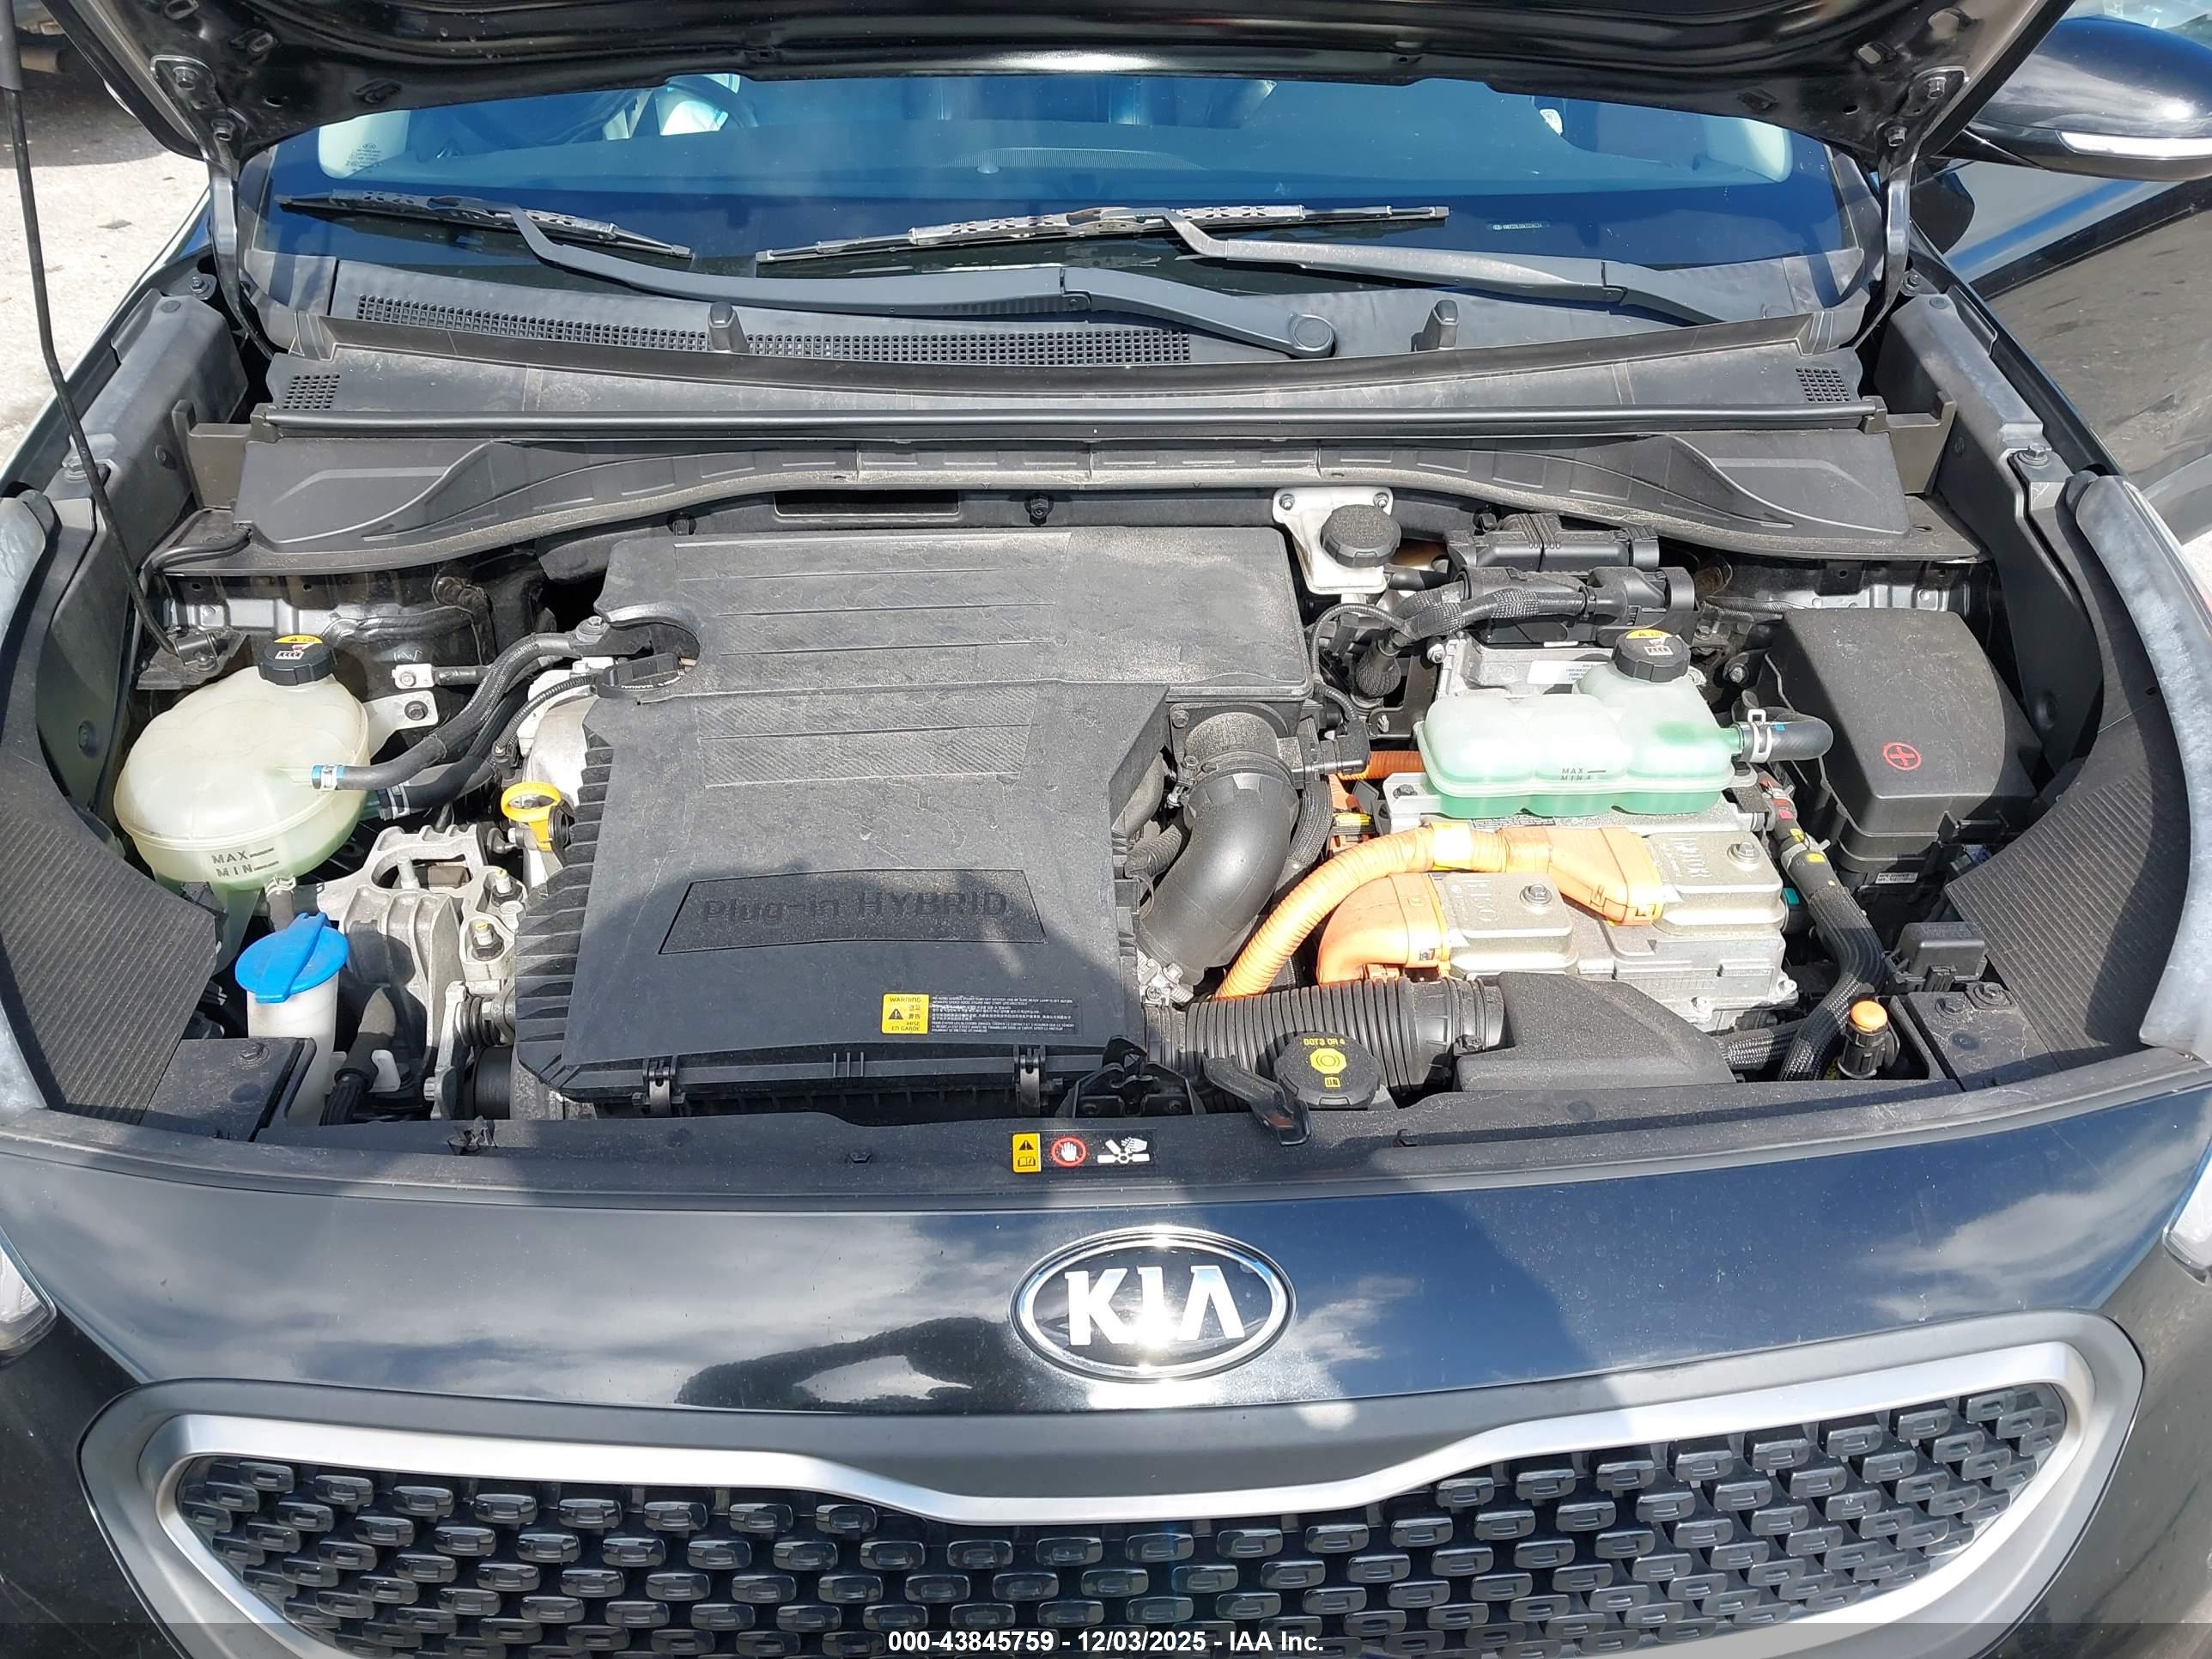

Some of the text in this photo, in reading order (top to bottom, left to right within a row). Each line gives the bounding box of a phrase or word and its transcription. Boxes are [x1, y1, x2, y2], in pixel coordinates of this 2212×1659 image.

[211, 851, 248, 864] MAX
[216, 864, 253, 877] MIN
[704, 891, 1007, 928] Plug-in HYBRID
[1064, 1265, 1247, 1347] KIA
